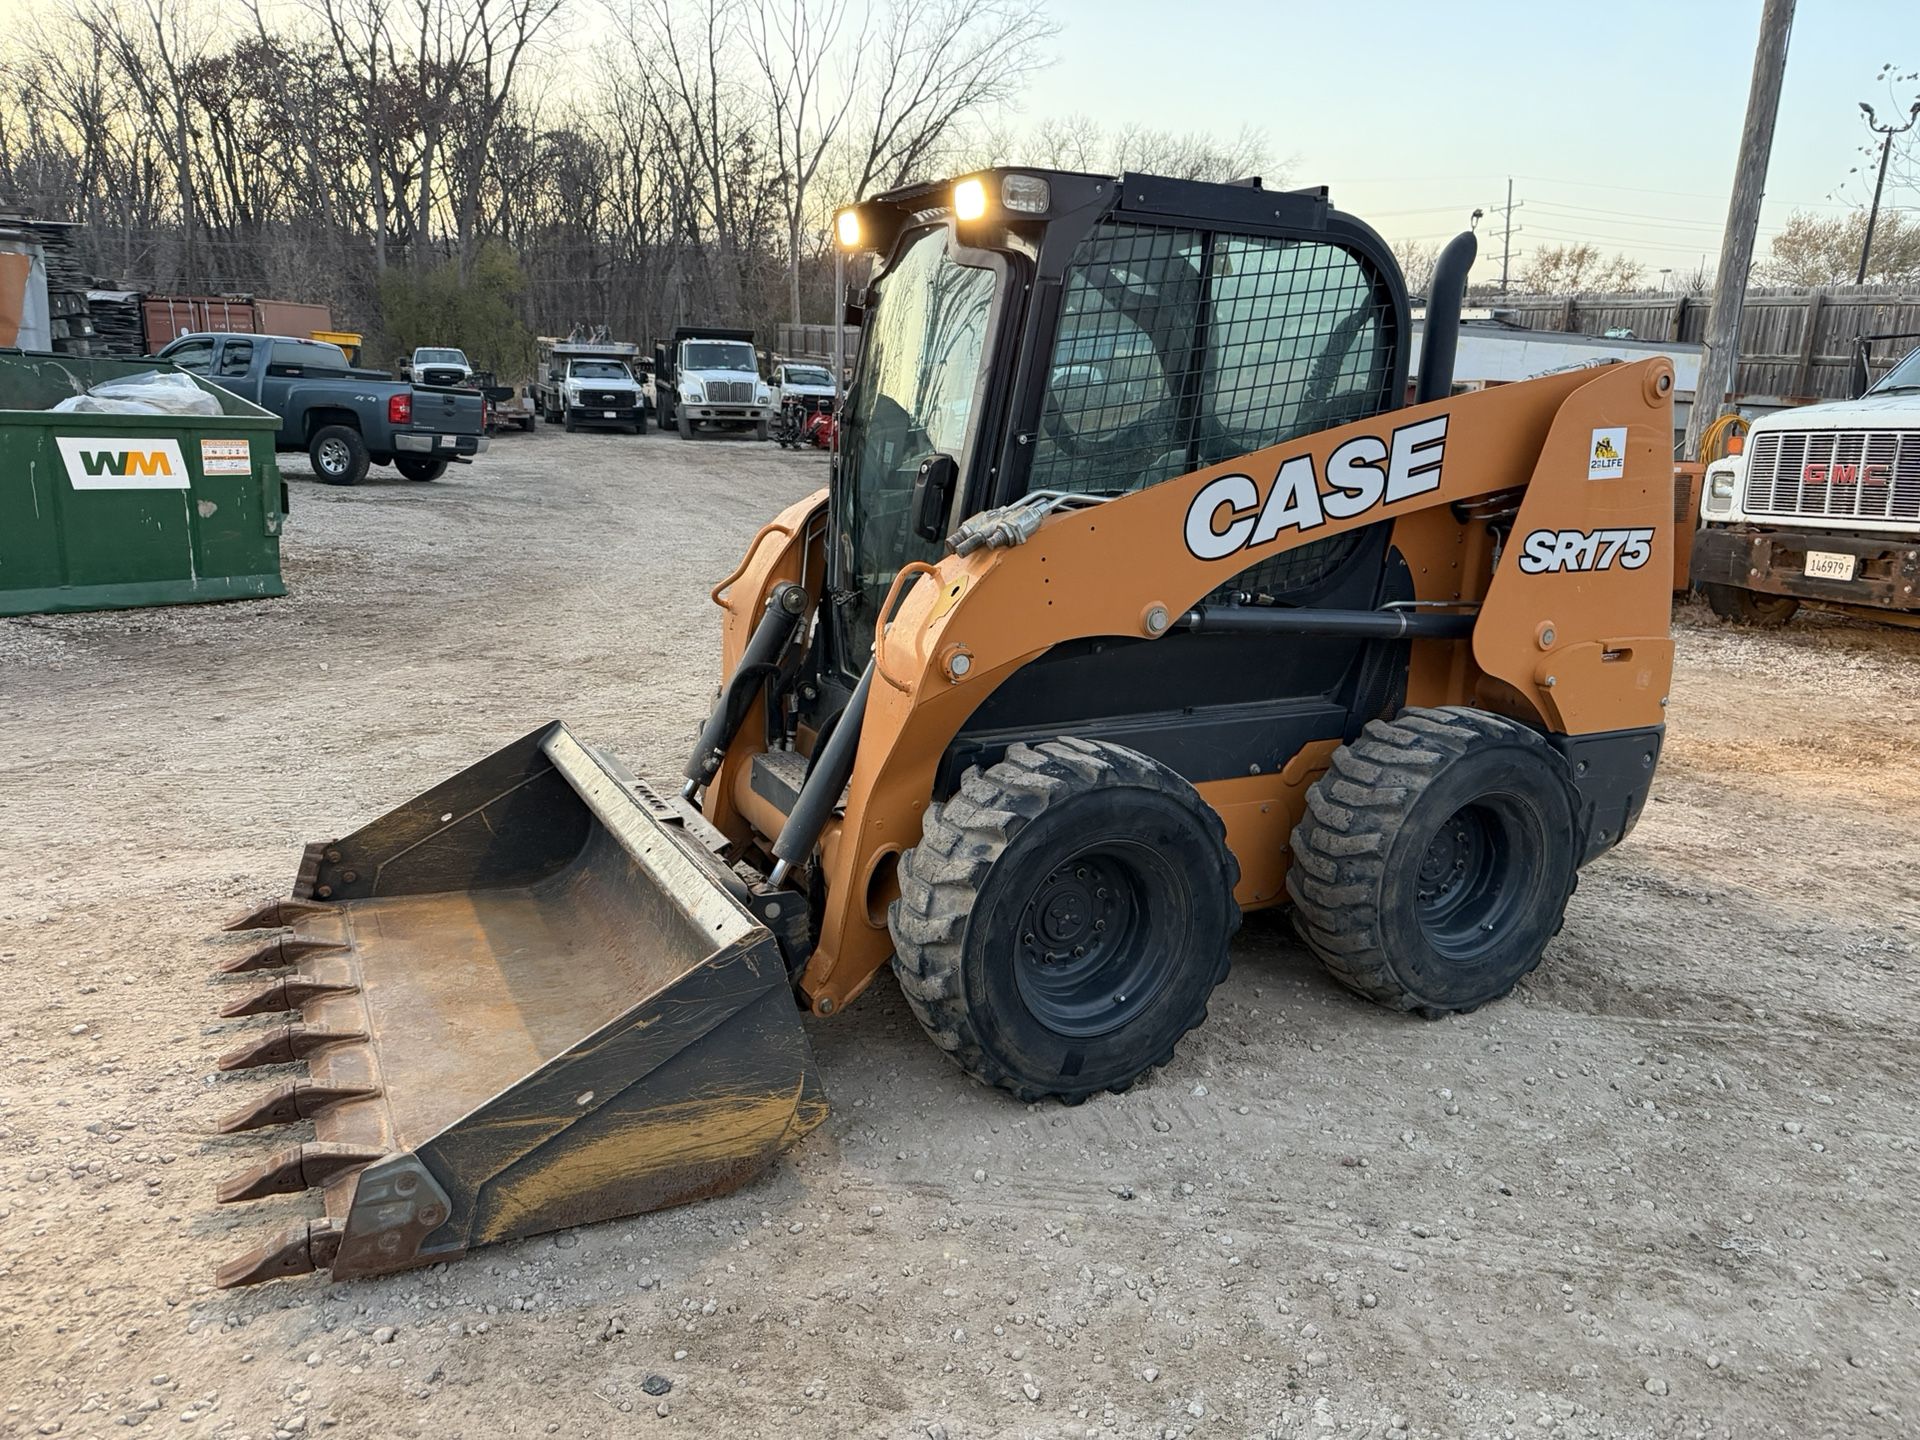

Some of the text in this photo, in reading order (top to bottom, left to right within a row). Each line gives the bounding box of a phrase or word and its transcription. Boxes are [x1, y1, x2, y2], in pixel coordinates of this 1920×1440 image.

[79, 451, 172, 476] WM
[1803, 464, 1889, 486] GMC
[1184, 414, 1450, 561] CASE
[1519, 528, 1655, 573] SR175
